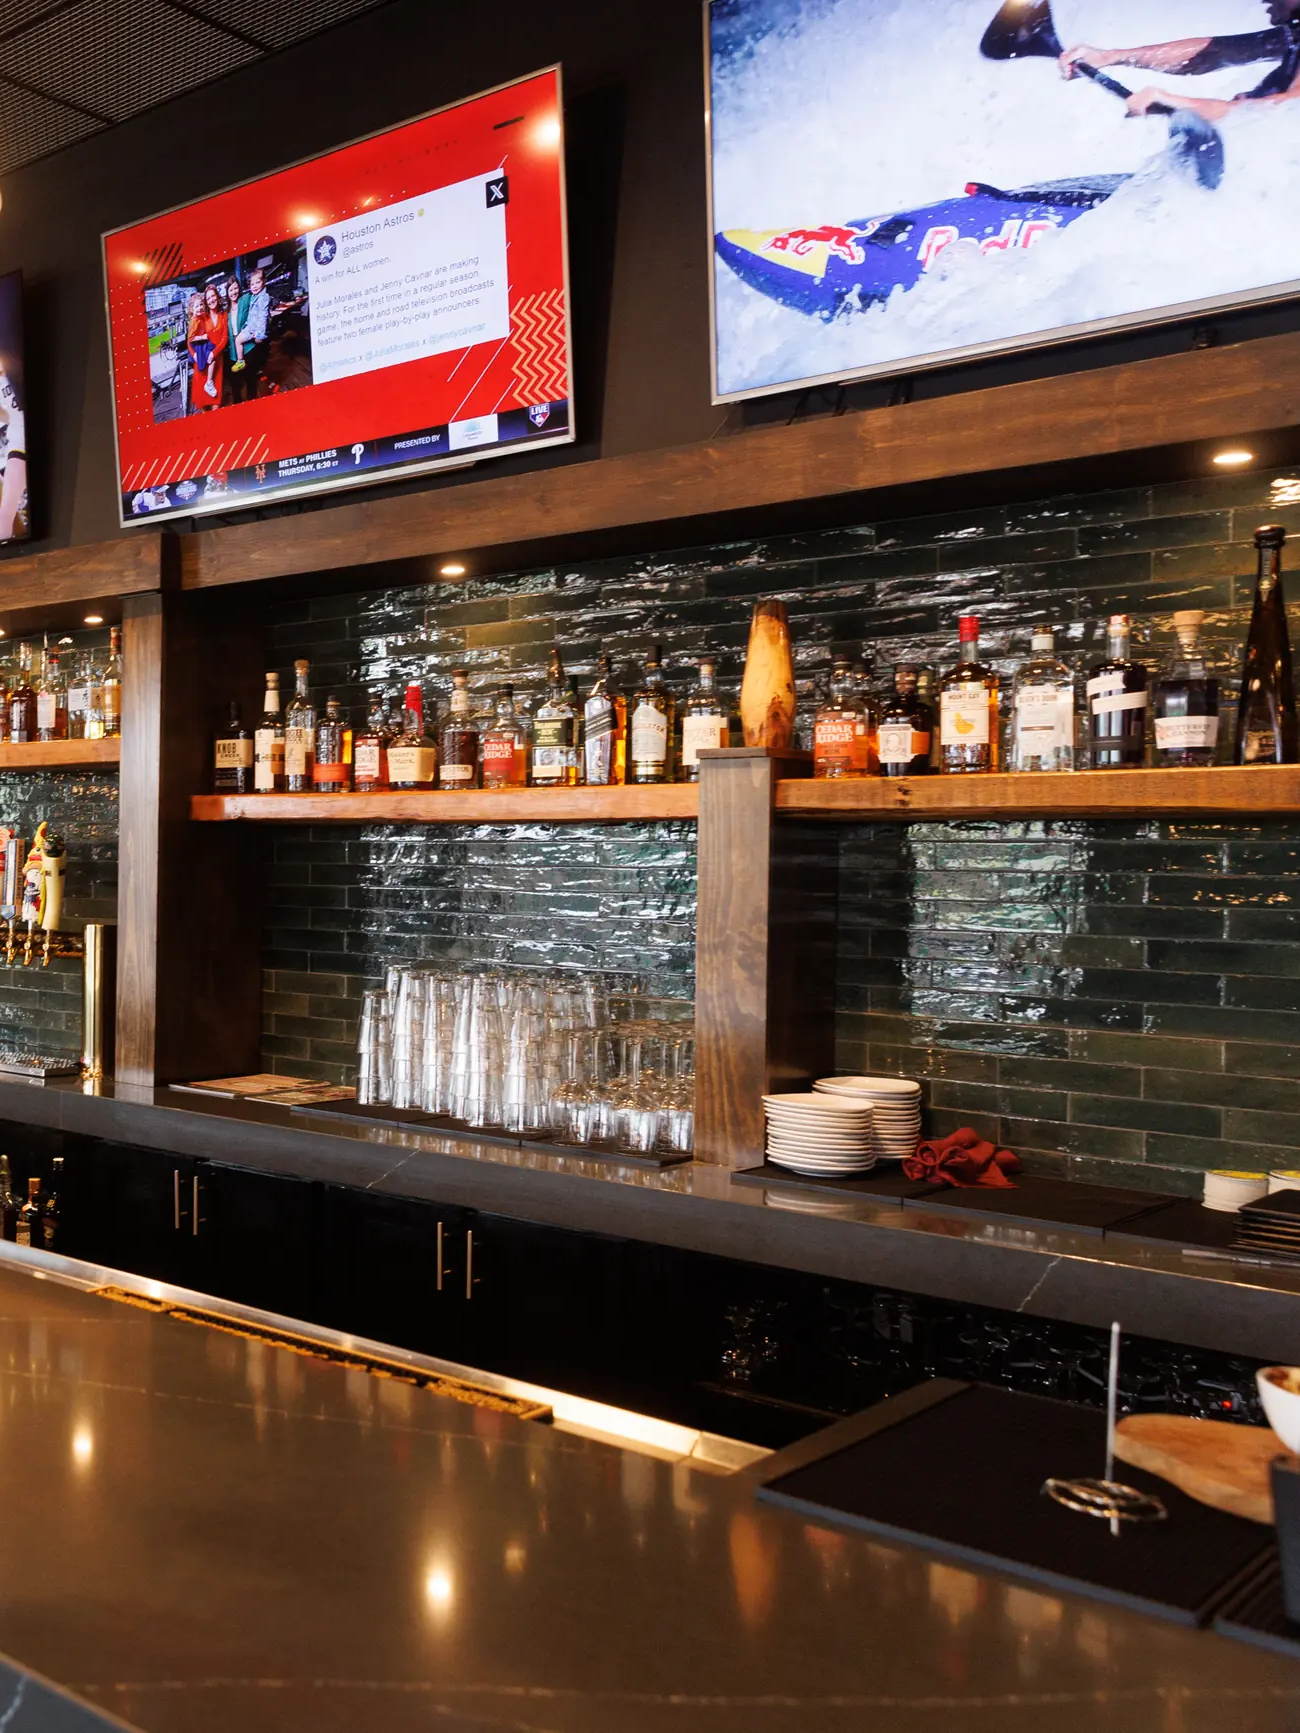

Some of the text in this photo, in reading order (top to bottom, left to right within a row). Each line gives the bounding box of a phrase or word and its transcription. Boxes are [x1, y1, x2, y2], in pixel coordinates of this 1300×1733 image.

[341, 212, 415, 242] Houston Astros
[343, 240, 374, 258] @astros
[335, 268, 345, 279] for
[346, 265, 361, 274] ALL
[316, 256, 479, 310] Julia Morales and Jenny Cavnar are making
[343, 305, 356, 315] For
[357, 301, 368, 310] the
[370, 296, 384, 306] first
[385, 292, 402, 302] time
[404, 289, 411, 297] in
[420, 279, 447, 293] regular
[449, 270, 479, 285] season
[340, 318, 352, 328] the
[354, 312, 375, 323] home
[376, 307, 391, 317] and
[392, 302, 410, 313] road
[411, 292, 448, 309] television
[449, 279, 495, 299] broadcasts
[317, 335, 342, 347] feature
[343, 331, 357, 340] two
[358, 323, 384, 336] female
[385, 310, 431, 329] play-by-play
[531, 404, 548, 415] LIVE
[394, 434, 441, 450] PRESENTED BY
[278, 457, 298, 468] METS
[305, 449, 337, 462] PHILLIES
[278, 464, 316, 478] THURSDAY,
[316, 462, 332, 470] 6:30
[815, 724, 853, 734] CEDAR
[815, 733, 854, 743] RIDGE
[217, 742, 237, 754] KNOB
[484, 743, 512, 751] CEDAR
